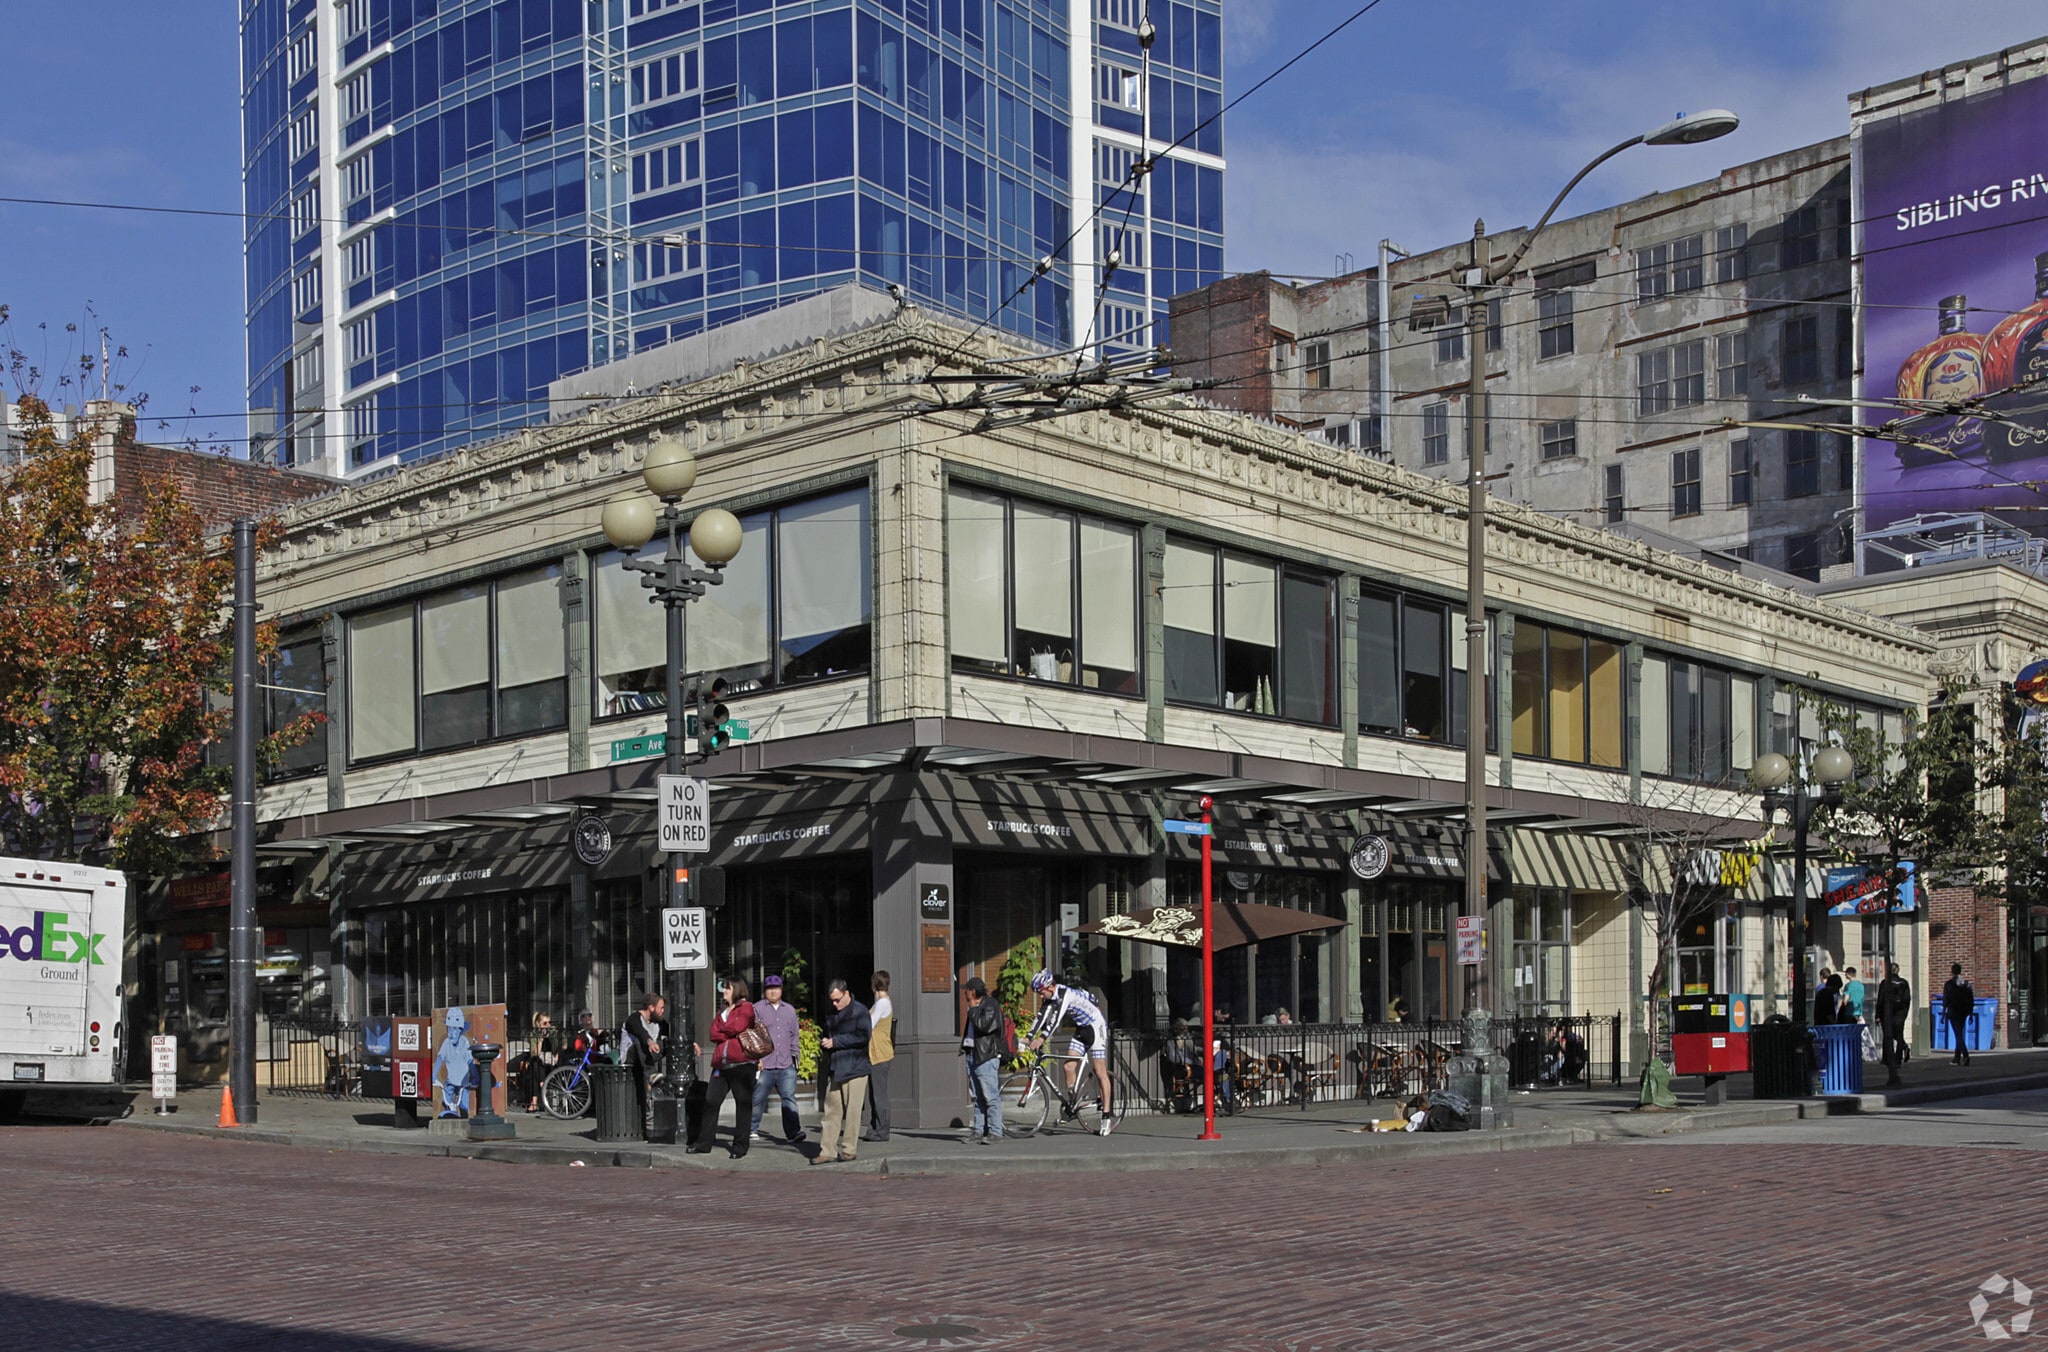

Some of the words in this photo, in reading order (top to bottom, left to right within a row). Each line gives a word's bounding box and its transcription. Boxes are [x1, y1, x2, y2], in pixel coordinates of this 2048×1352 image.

[1897, 185, 2000, 231] SIBLING
[724, 725, 734, 737] St
[615, 742, 626, 759] 1st
[648, 739, 663, 751] Ave
[673, 785, 695, 801] NO
[667, 804, 702, 821] TURN
[663, 824, 680, 841] ON
[683, 825, 706, 841] RED
[987, 820, 1039, 834] STARBUCKS
[1039, 824, 1071, 837] COFFEE
[733, 829, 791, 847] STARBUCKS
[792, 824, 831, 839] COFFEE
[1224, 840, 1267, 852] ESTABLISHED
[1274, 844, 1289, 853] 1971
[1404, 854, 1438, 866] STARBUCKS
[1437, 856, 1459, 867] COFFEE
[418, 873, 462, 886] STARBUCKS
[462, 868, 492, 881] COFFEE
[173, 884, 205, 897] WELLS
[206, 879, 231, 893] FARG
[923, 899, 947, 907] clover
[669, 914, 700, 927] ONE
[1458, 919, 1468, 928] NO
[669, 930, 701, 944] WAY
[1459, 930, 1479, 938] PARKING
[1464, 940, 1473, 948] ANY
[40, 966, 78, 980] Ground
[405, 1029, 416, 1037] USA
[153, 1037, 164, 1045] NO
[400, 1037, 416, 1045] TODAY
[402, 1073, 415, 1085] City
[402, 1083, 415, 1093] Arts
